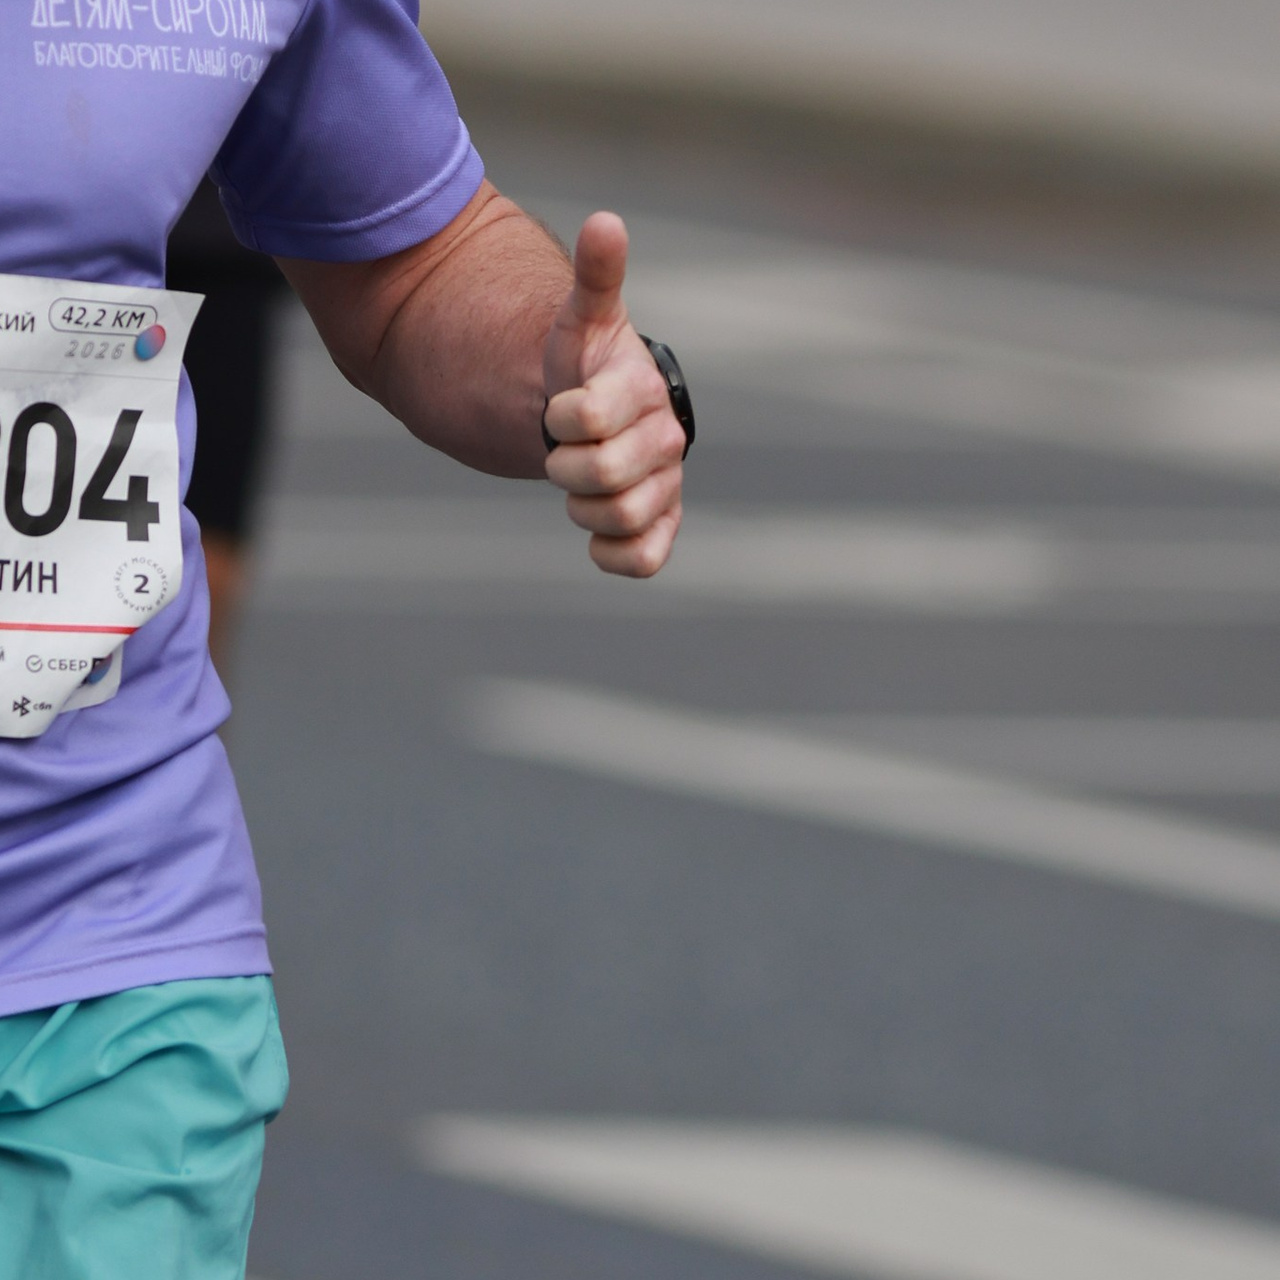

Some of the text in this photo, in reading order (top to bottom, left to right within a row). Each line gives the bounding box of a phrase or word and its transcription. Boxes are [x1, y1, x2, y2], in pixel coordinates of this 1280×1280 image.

[33, 41, 264, 83] БЛАГОТВОРИТЕЛЬНЫЙ ФОН
[62, 306, 146, 329] 42,2 КМ
[133, 574, 150, 594] 2
[48, 659, 88, 671] СБЕР
